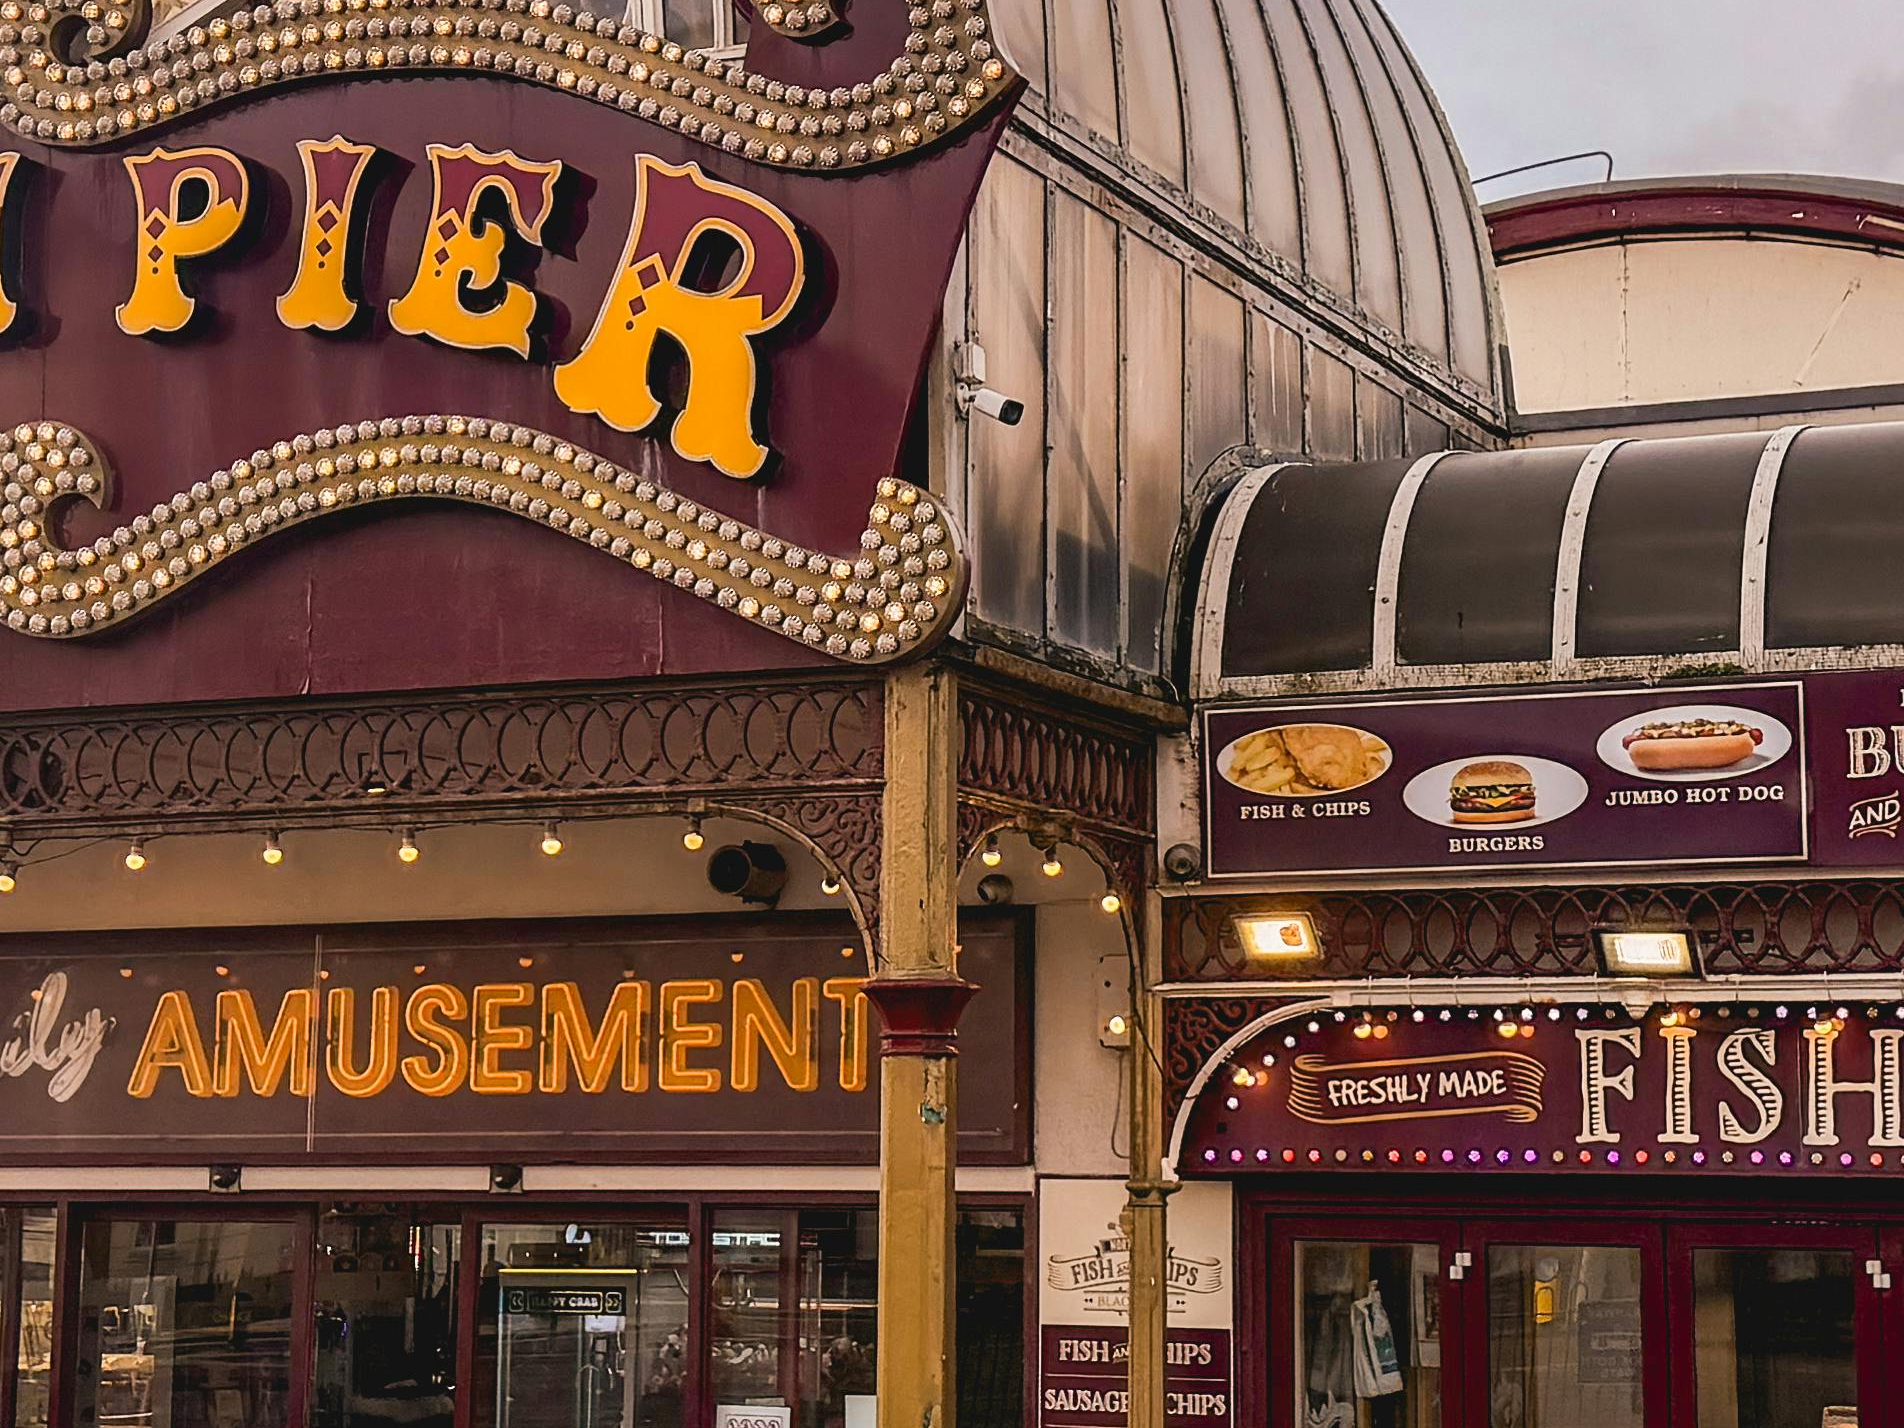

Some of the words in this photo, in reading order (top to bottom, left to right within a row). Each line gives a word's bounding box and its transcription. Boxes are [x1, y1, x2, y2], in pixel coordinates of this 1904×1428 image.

[115, 133, 810, 479] PIER
[1605, 788, 1678, 807] JUMBO
[1686, 787, 1731, 803] HOT
[1739, 785, 1785, 802] DOG
[1240, 803, 1286, 820] FISH
[1292, 803, 1305, 818] &
[1311, 800, 1371, 818] CHIPS
[1848, 799, 1901, 830] AND
[1448, 834, 1545, 854] BURGERS
[127, 977, 869, 1097] AMUSEMENT
[1328, 1075, 1432, 1107] FRESHLY
[1438, 1070, 1506, 1099] MADE
[1070, 1258, 1114, 1285] FISH
[1168, 1260, 1198, 1286] IPS
[569, 1295, 598, 1307] CRAB
[1059, 1339, 1109, 1362] FISH
[1045, 1389, 1129, 1413] SAUSAGE
[1167, 1392, 1227, 1416] CHIPS
